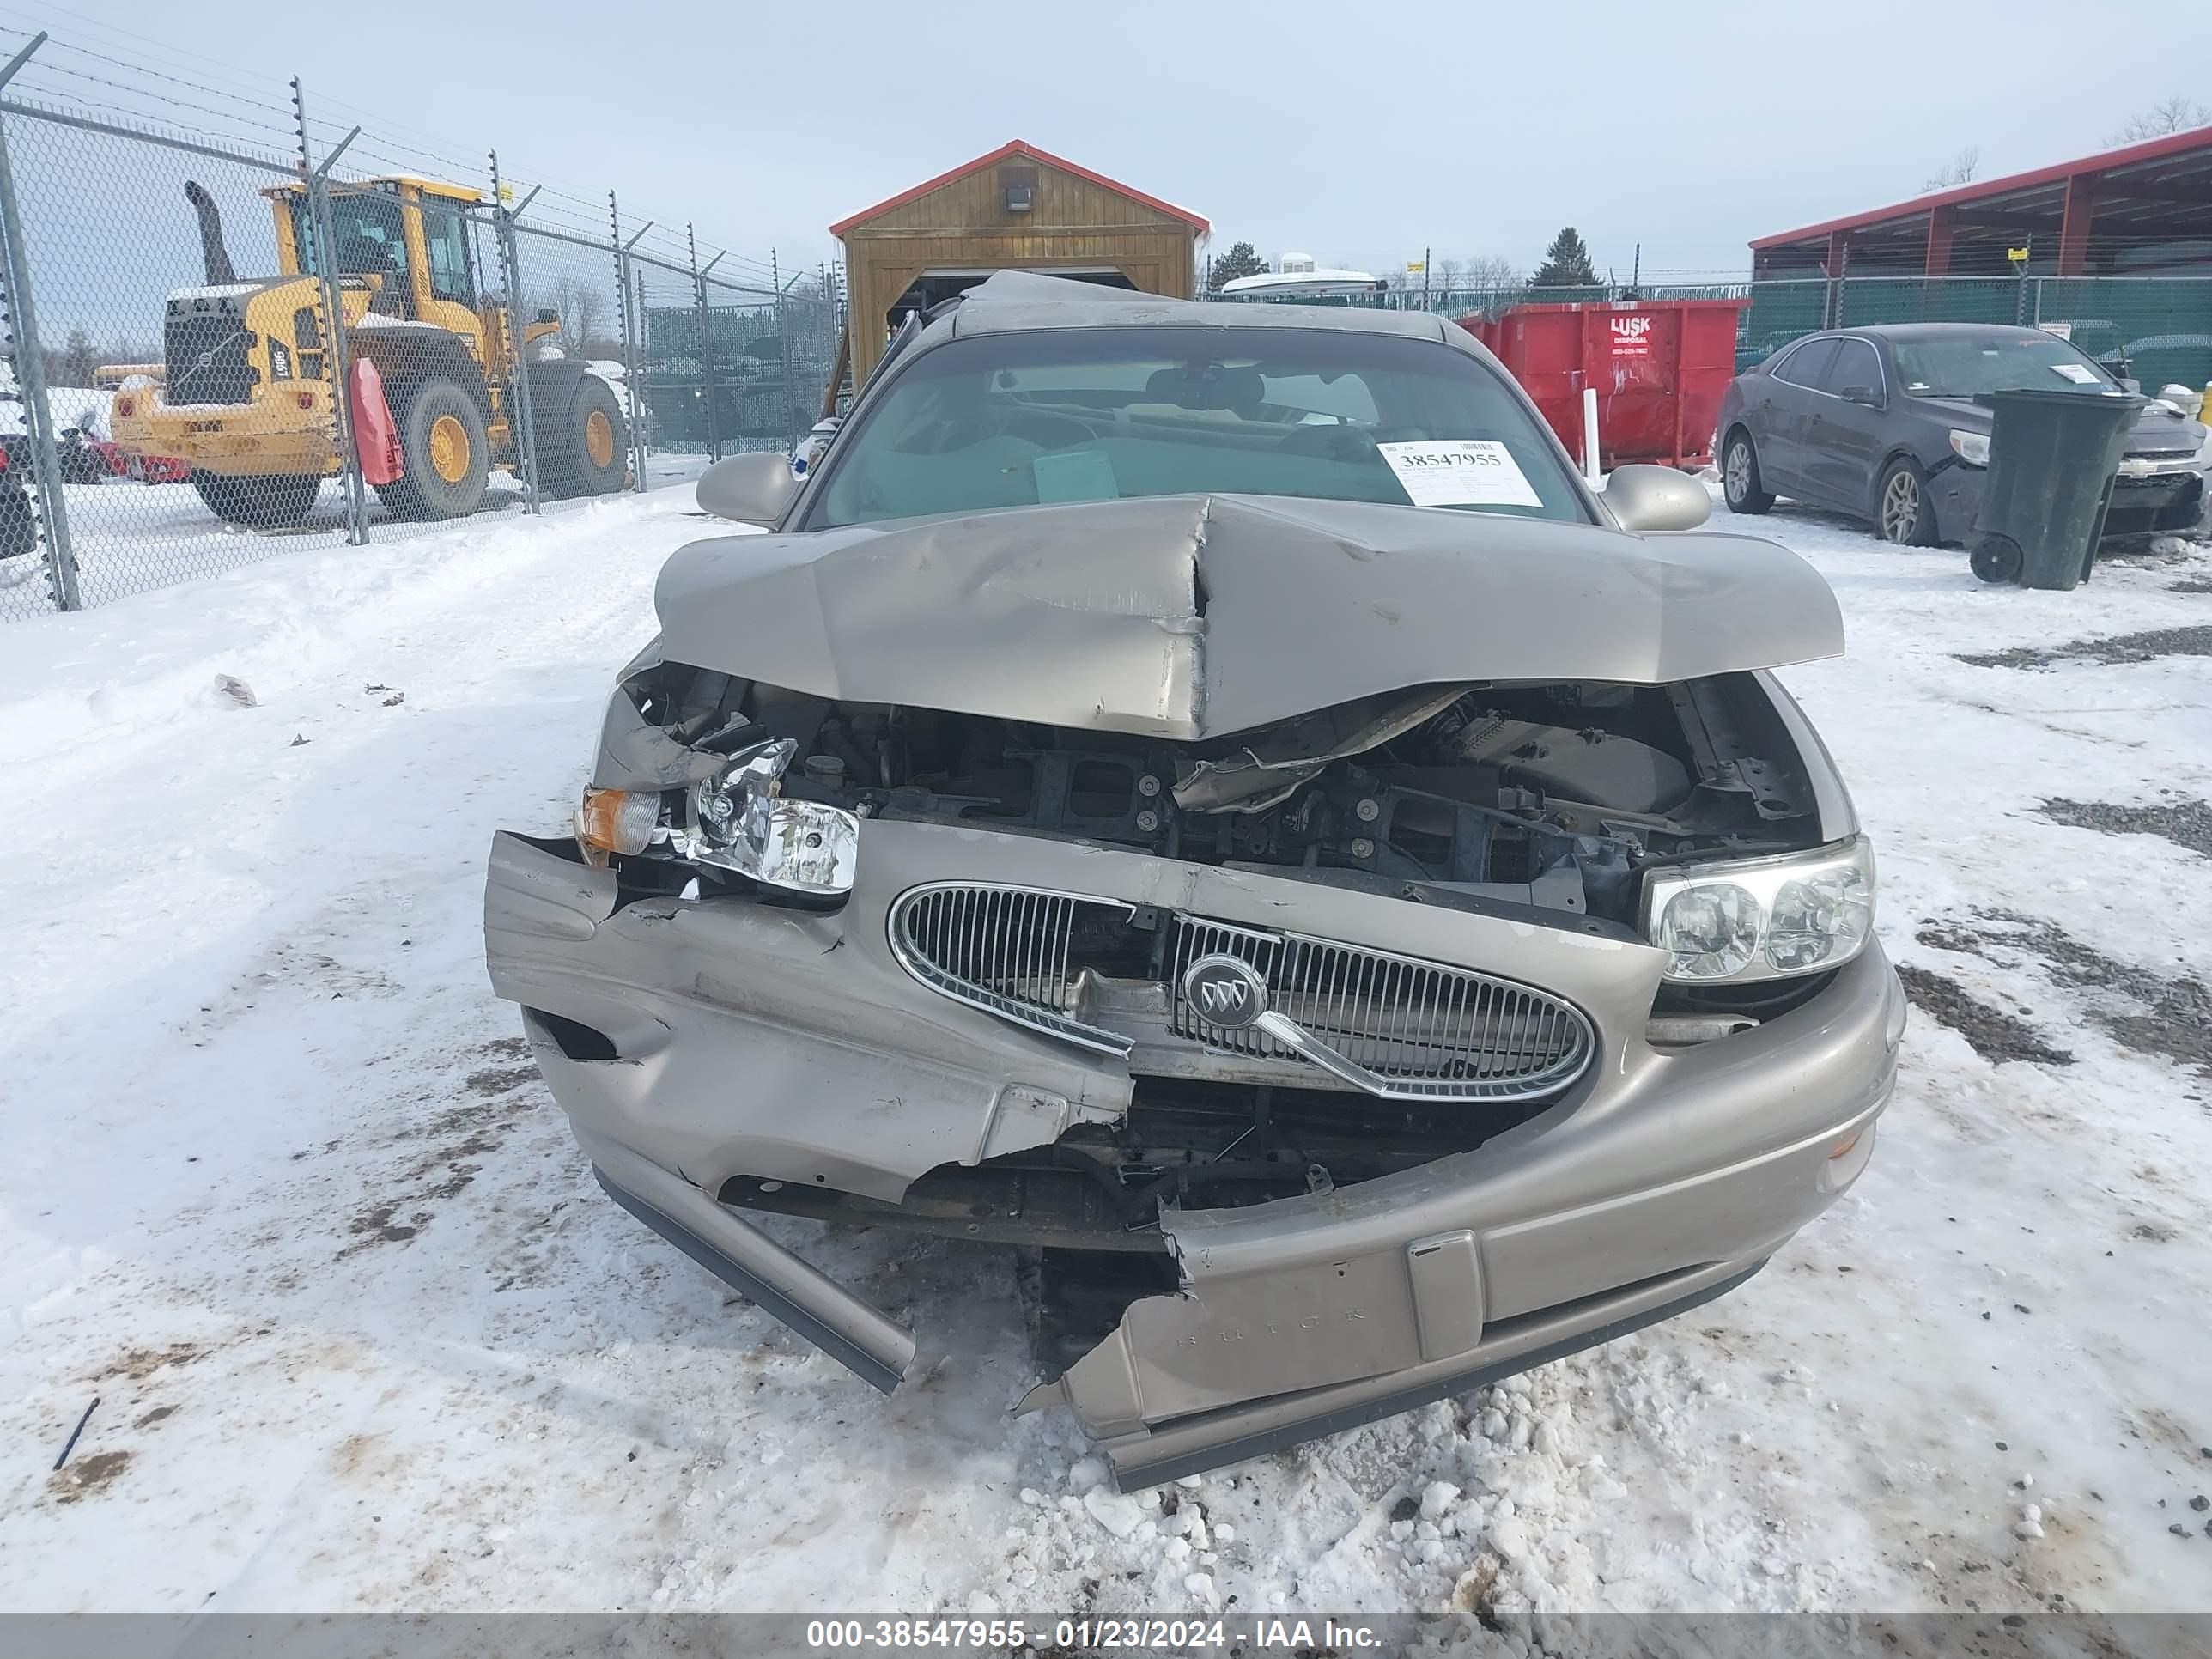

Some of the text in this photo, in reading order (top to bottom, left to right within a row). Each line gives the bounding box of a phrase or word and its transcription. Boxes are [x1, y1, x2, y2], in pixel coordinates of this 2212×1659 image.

[1610, 317, 1651, 337] LUSK
[274, 350, 289, 377] L90G
[1400, 453, 1502, 468] 38547955
[1174, 1308, 1368, 1348] BUICK
